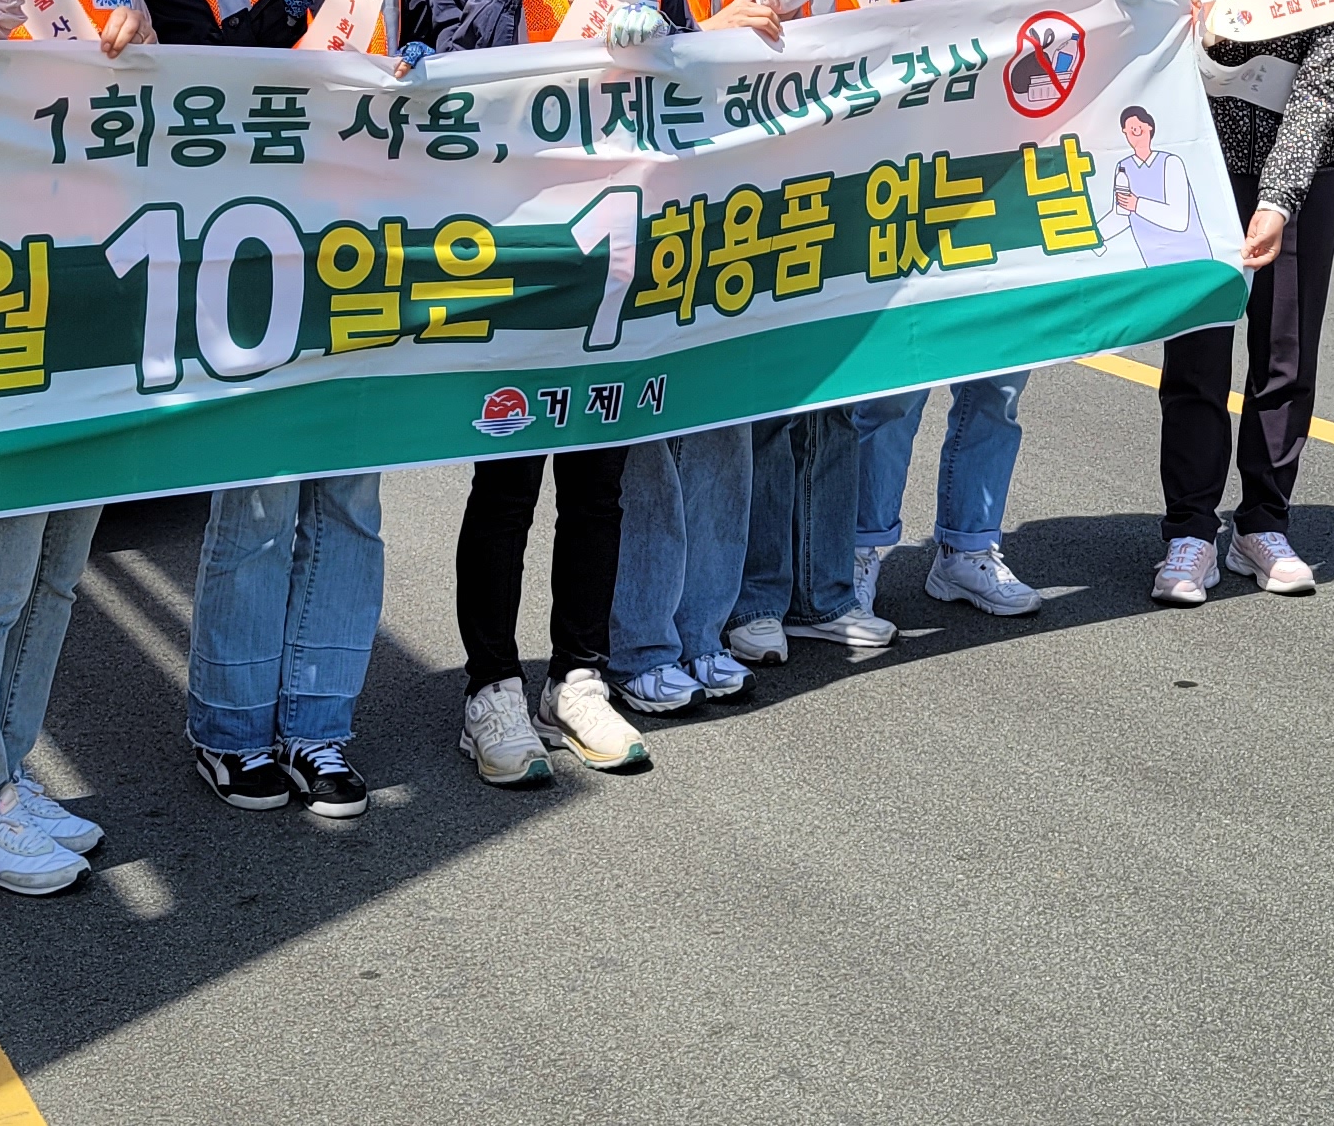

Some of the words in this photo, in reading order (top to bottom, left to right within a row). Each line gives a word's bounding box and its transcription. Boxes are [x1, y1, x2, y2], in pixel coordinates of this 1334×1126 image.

[33, 84, 312, 168] 1회용품
[338, 88, 509, 165] 사용,
[530, 74, 715, 154] 이제는
[723, 61, 882, 139] 헤어질
[897, 35, 990, 107] 결심
[571, 170, 836, 352] 1회용품
[864, 152, 997, 279] 없는
[1021, 134, 1101, 258] 날
[536, 376, 667, 428] 거제시
